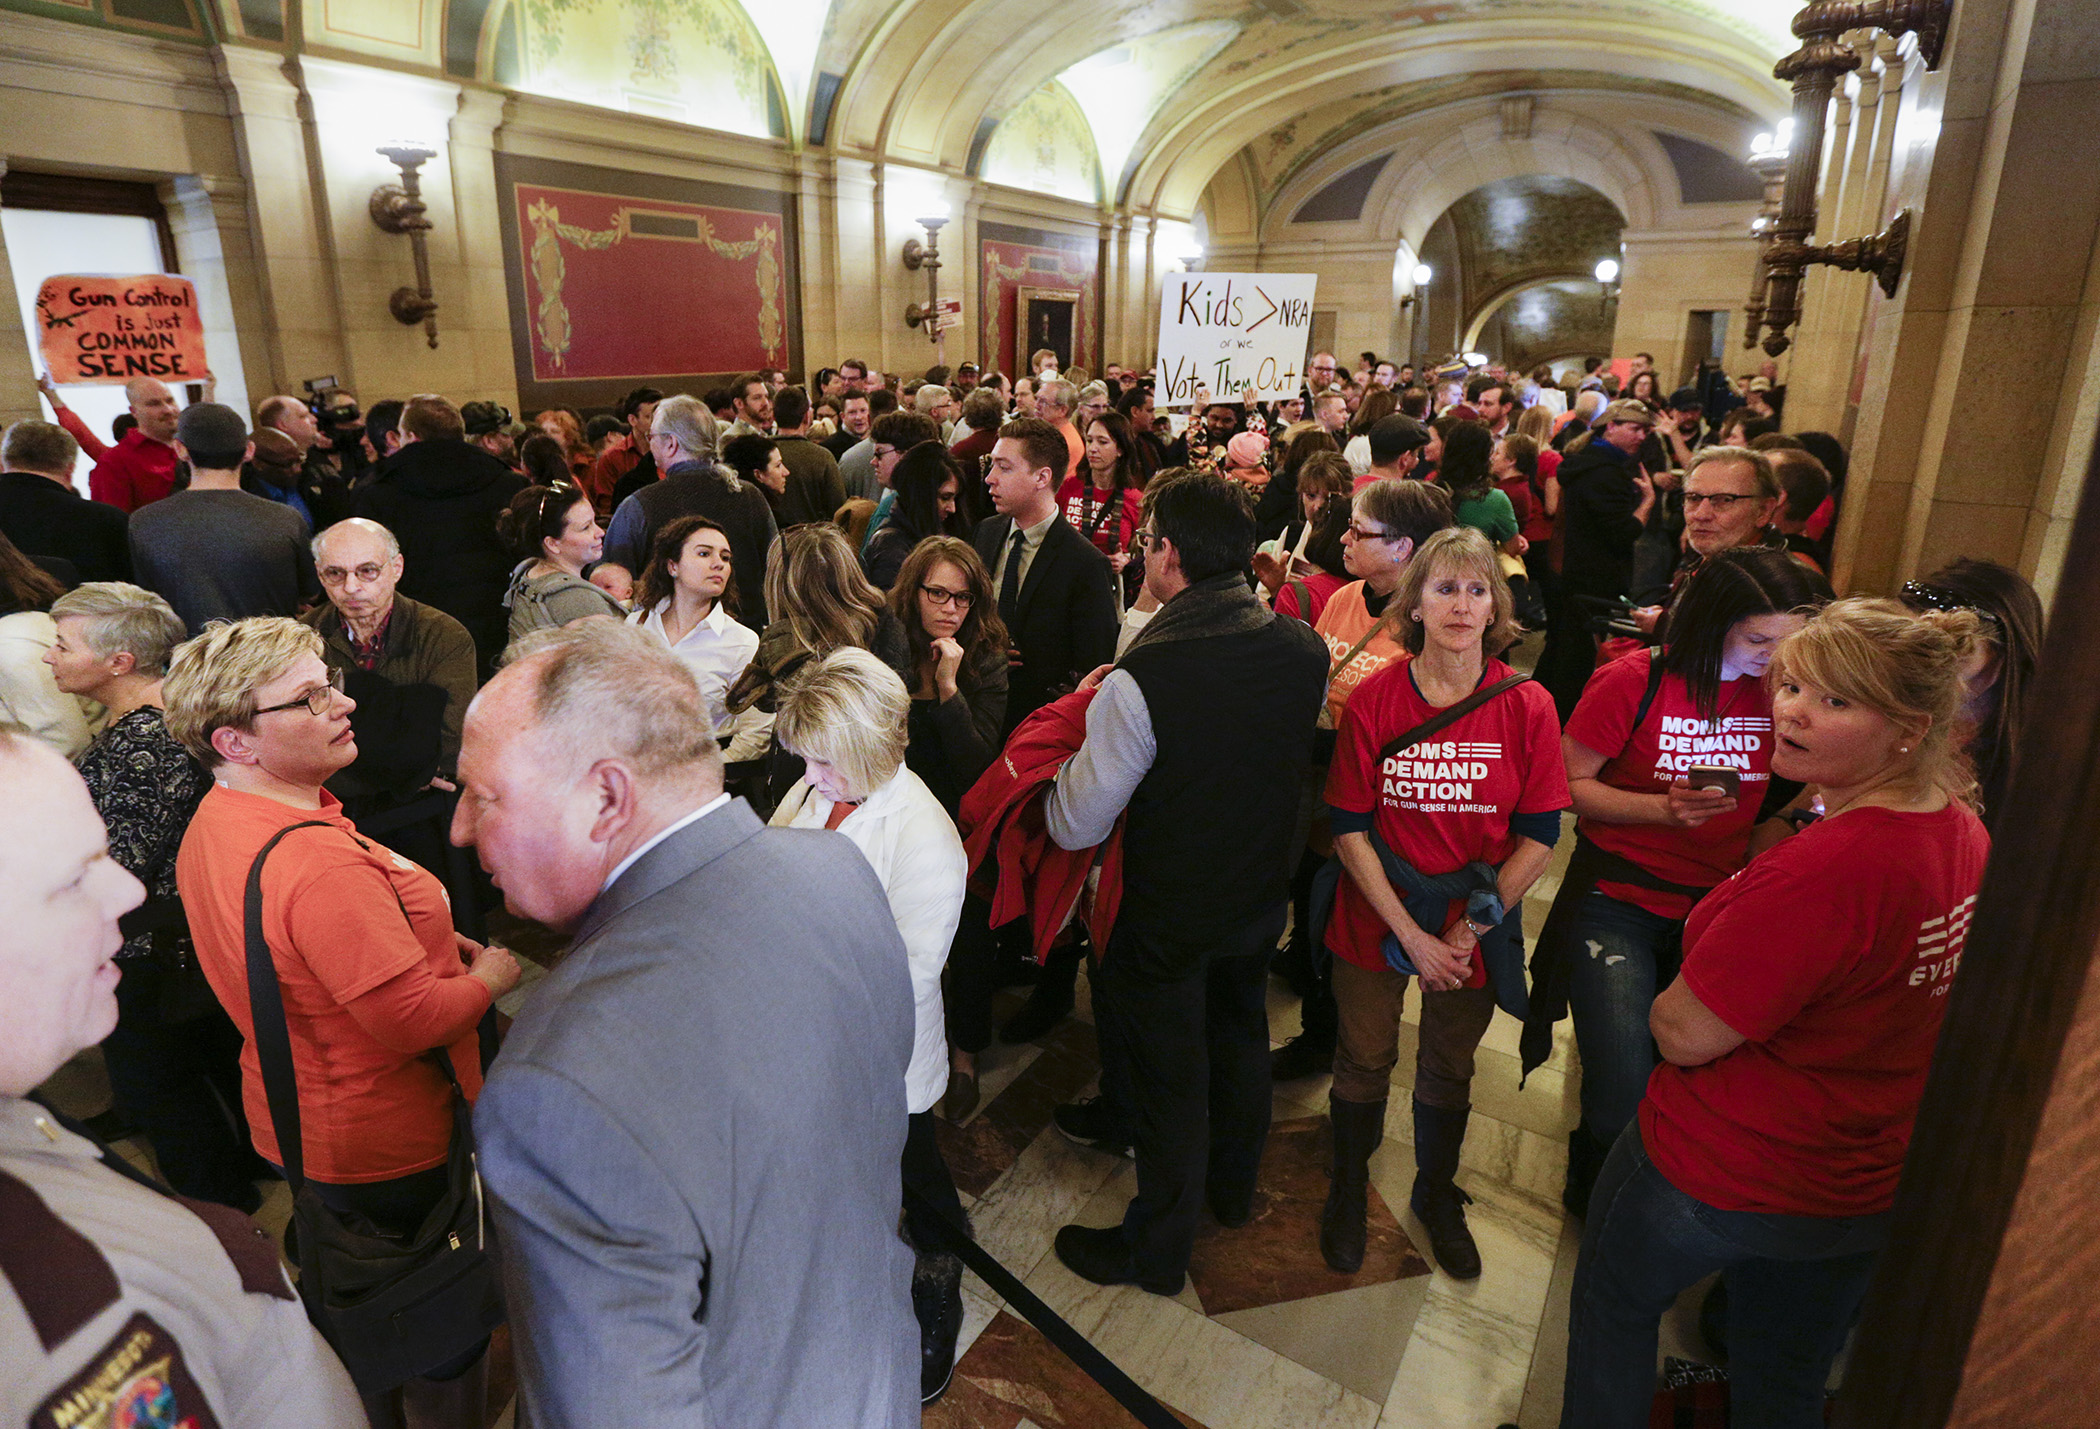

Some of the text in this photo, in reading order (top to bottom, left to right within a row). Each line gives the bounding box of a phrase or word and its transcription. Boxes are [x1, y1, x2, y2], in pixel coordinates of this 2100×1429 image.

[69, 286, 190, 307] Gun Control
[1178, 279, 1243, 327] Kids
[1279, 298, 1308, 327] NRA
[116, 314, 135, 331] is
[77, 332, 176, 351] COMMON
[1219, 338, 1253, 349] or we
[77, 353, 189, 377] SENSE
[1162, 355, 1206, 402] Vote
[1256, 356, 1295, 391] Out
[1324, 631, 1387, 674] PROECT
[1396, 741, 1457, 760] OMS
[1658, 734, 1761, 753] DEMAND
[1382, 757, 1488, 780] DEMAND
[1655, 752, 1751, 771] ACTION
[1653, 771, 1672, 781] FOR
[1382, 778, 1472, 800] ACTION
[1383, 797, 1497, 814] FOR GUN SENSE IN AMERICA
